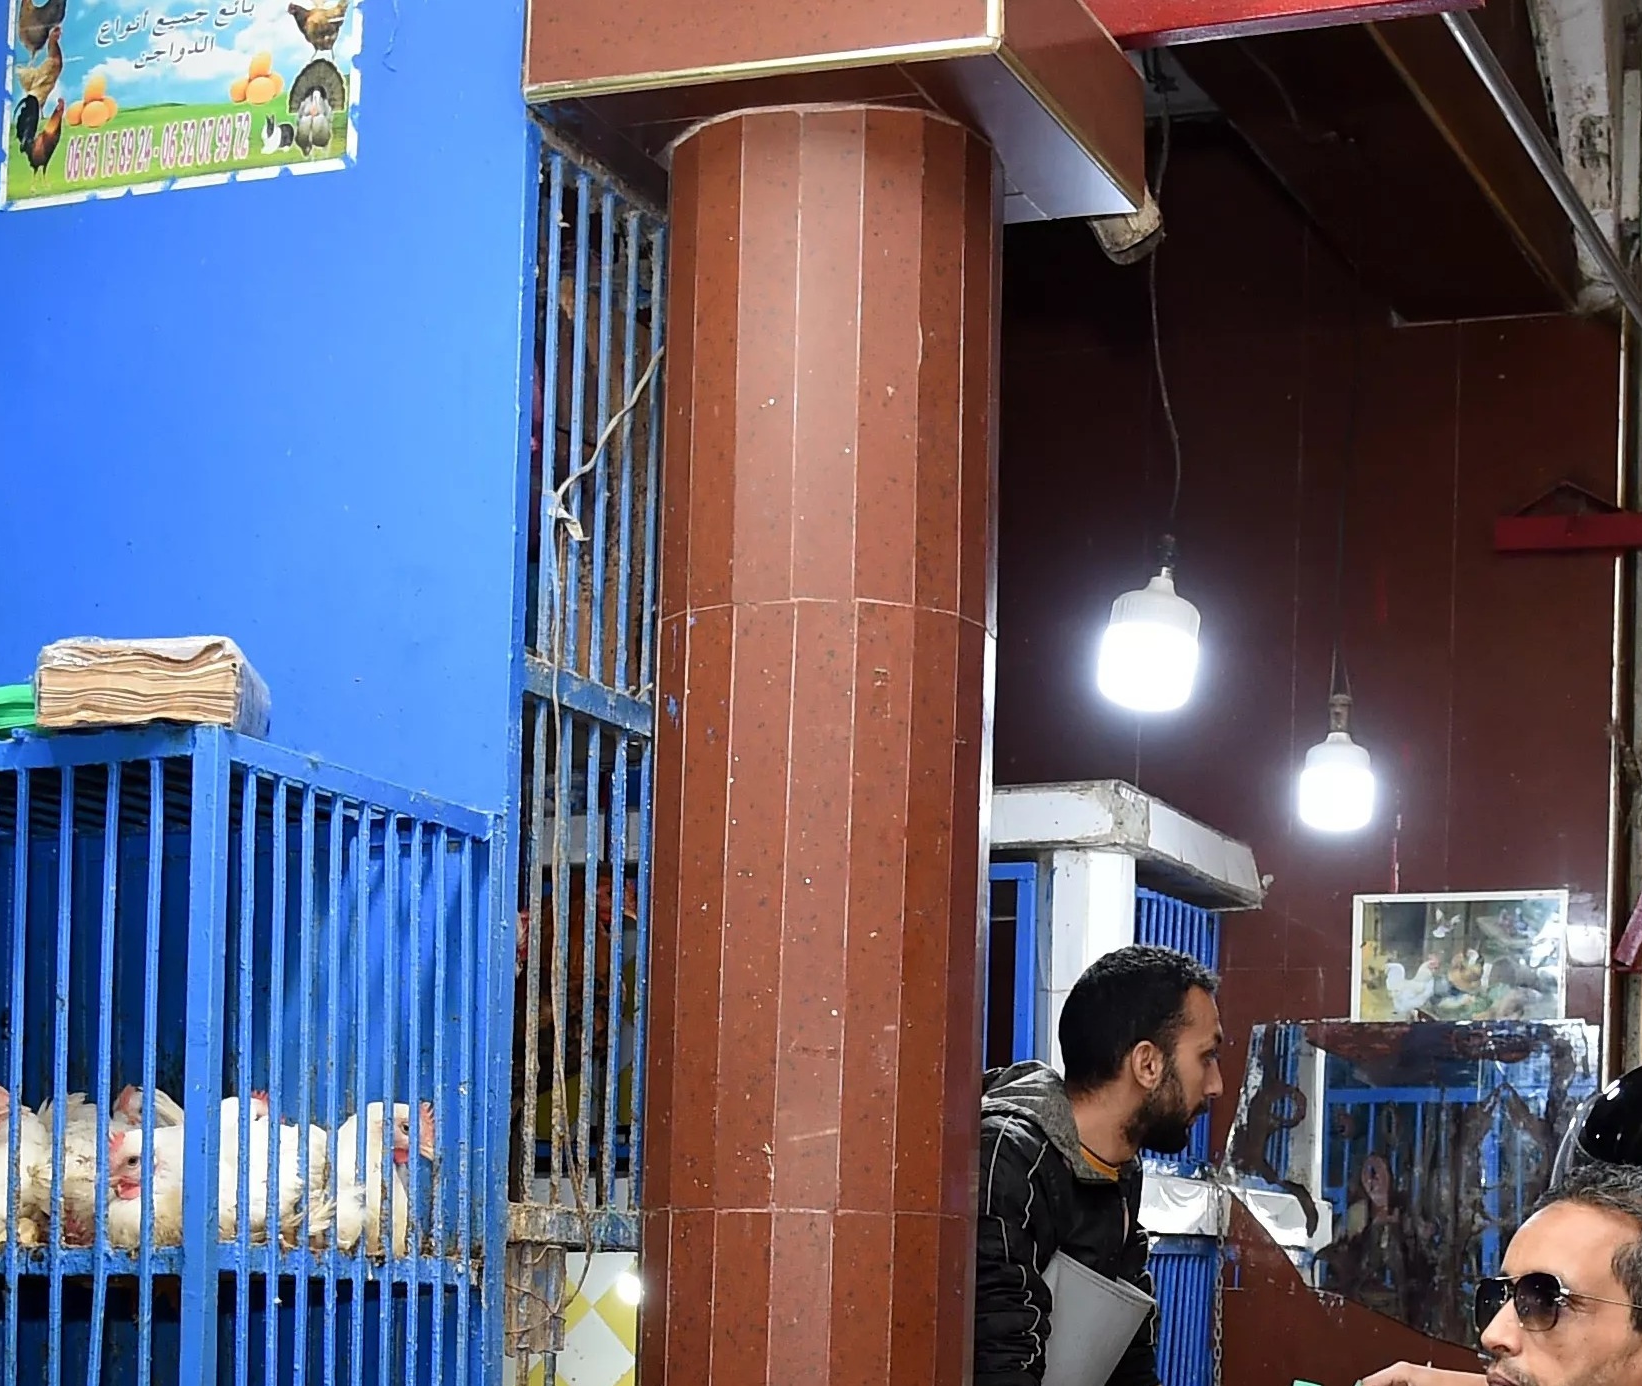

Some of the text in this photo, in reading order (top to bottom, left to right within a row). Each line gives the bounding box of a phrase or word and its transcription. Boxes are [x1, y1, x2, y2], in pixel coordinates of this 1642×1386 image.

[97, 10, 149, 44] أنواع
[153, 11, 208, 36] جميع
[134, 36, 215, 69] الدواجن
[66, 136, 82, 181] 06
[83, 134, 100, 179] 63
[101, 131, 117, 178] 15
[117, 128, 135, 174] 89
[135, 125, 152, 172] 24
[160, 121, 178, 169] 06
[178, 120, 197, 166] 32
[197, 117, 215, 165] 07
[214, 115, 232, 162] 99
[233, 111, 251, 159] 72
